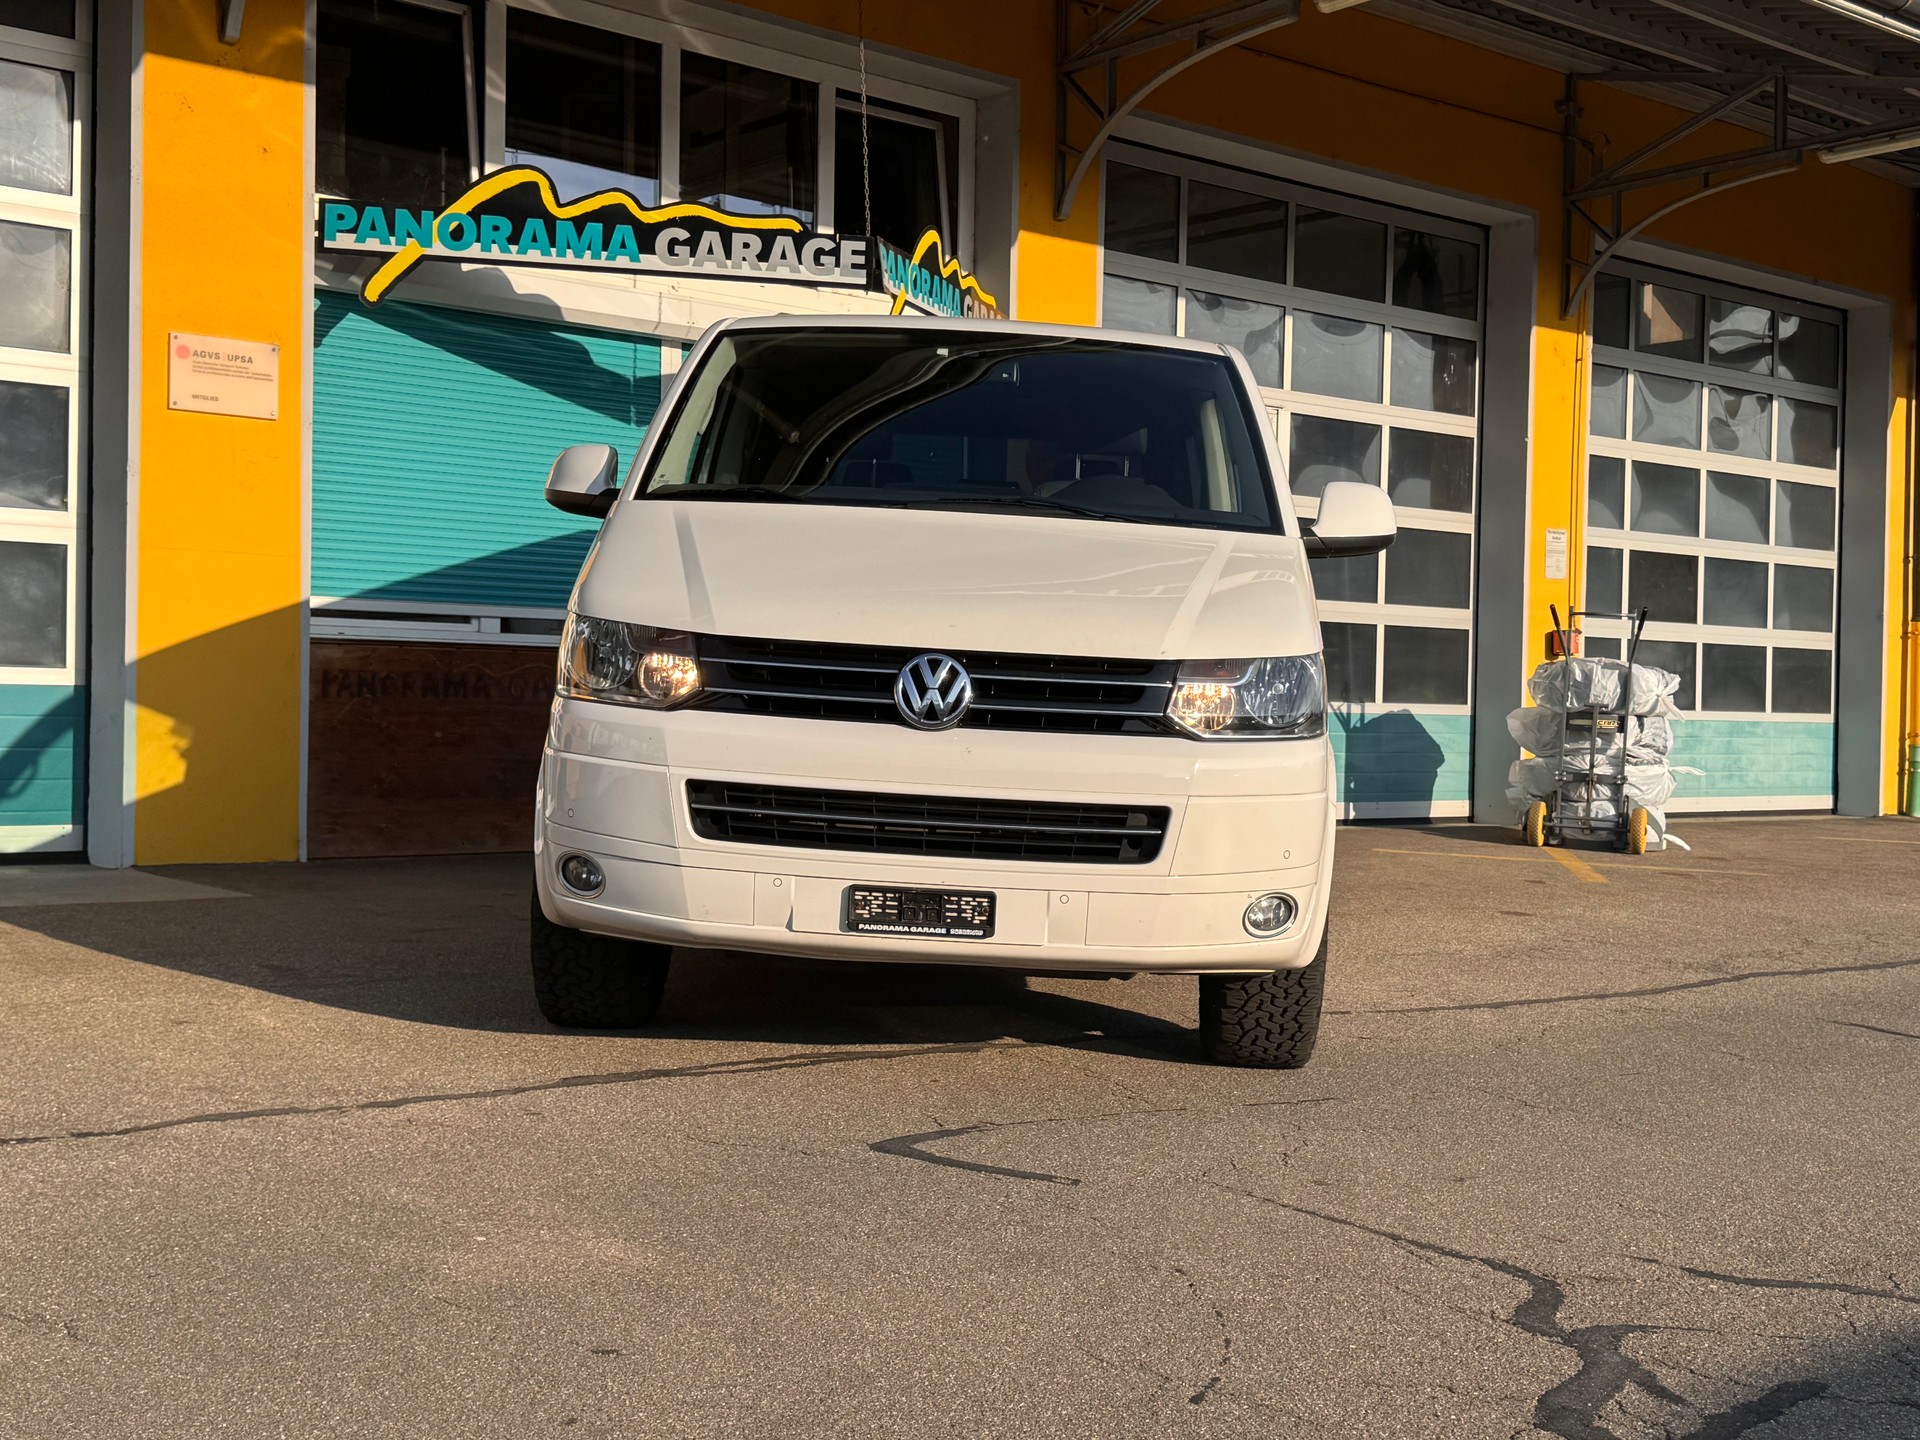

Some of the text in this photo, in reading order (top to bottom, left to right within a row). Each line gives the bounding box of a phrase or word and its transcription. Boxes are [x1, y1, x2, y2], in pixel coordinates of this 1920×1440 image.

[324, 203, 867, 278] PANORAMA GARAGE
[880, 243, 960, 317] PANORAMA
[192, 350, 254, 364] AGVS UPSA
[858, 923, 910, 932] PANORAMA
[910, 926, 947, 934] GARAGE
